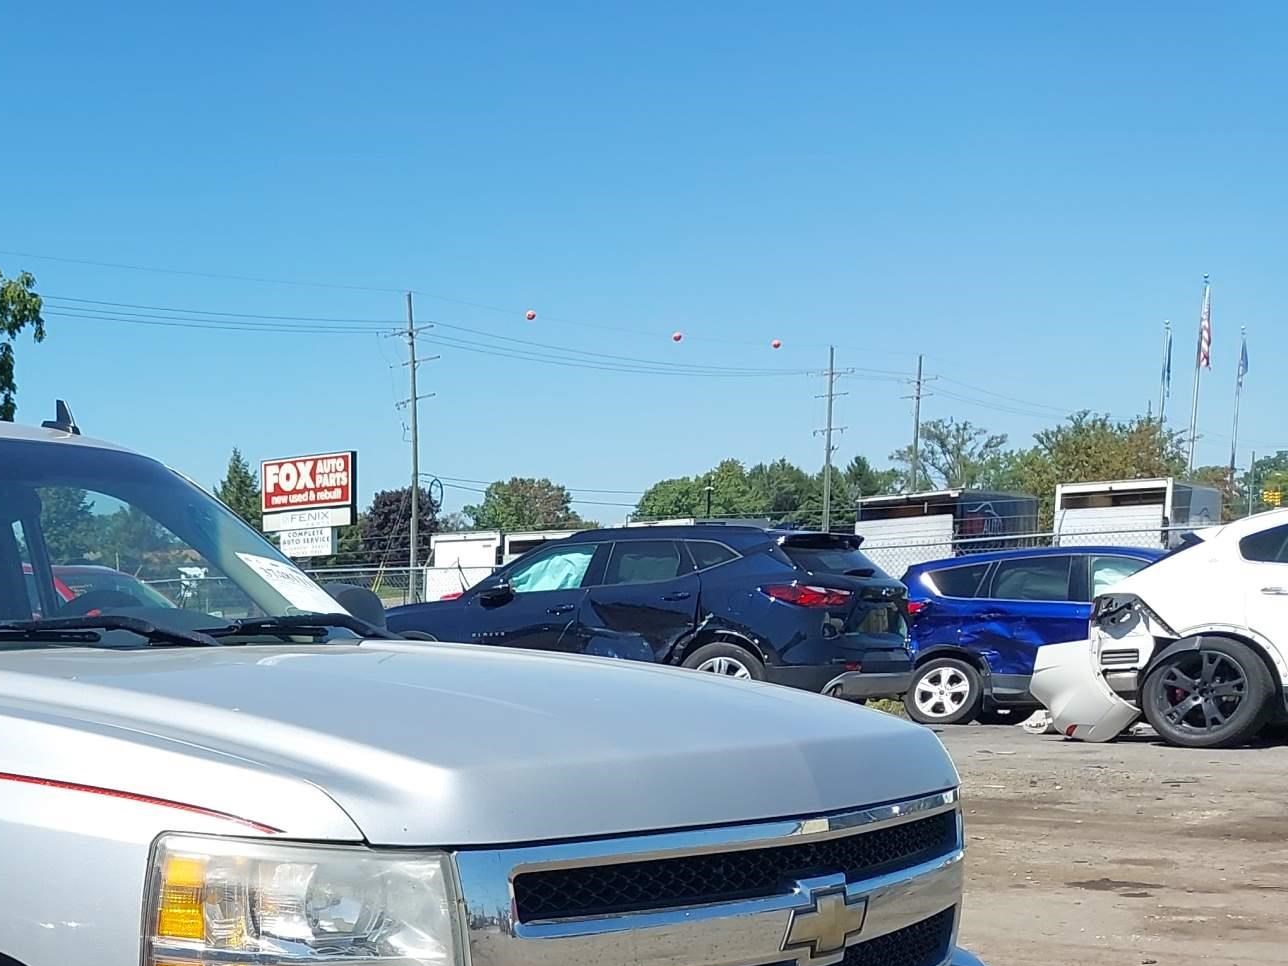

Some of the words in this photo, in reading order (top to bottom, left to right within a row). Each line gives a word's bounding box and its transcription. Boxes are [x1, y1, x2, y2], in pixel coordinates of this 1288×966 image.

[316, 458, 345, 474] AUTO
[265, 461, 316, 493] FOX
[316, 472, 348, 488] PARTS
[271, 494, 288, 506] new
[289, 491, 309, 503] used
[316, 487, 343, 501] rebuilt
[290, 511, 329, 523] FENIX
[282, 538, 301, 546] AUTO
[303, 536, 330, 545] SERVICE
[287, 529, 324, 538] COMPLETE
